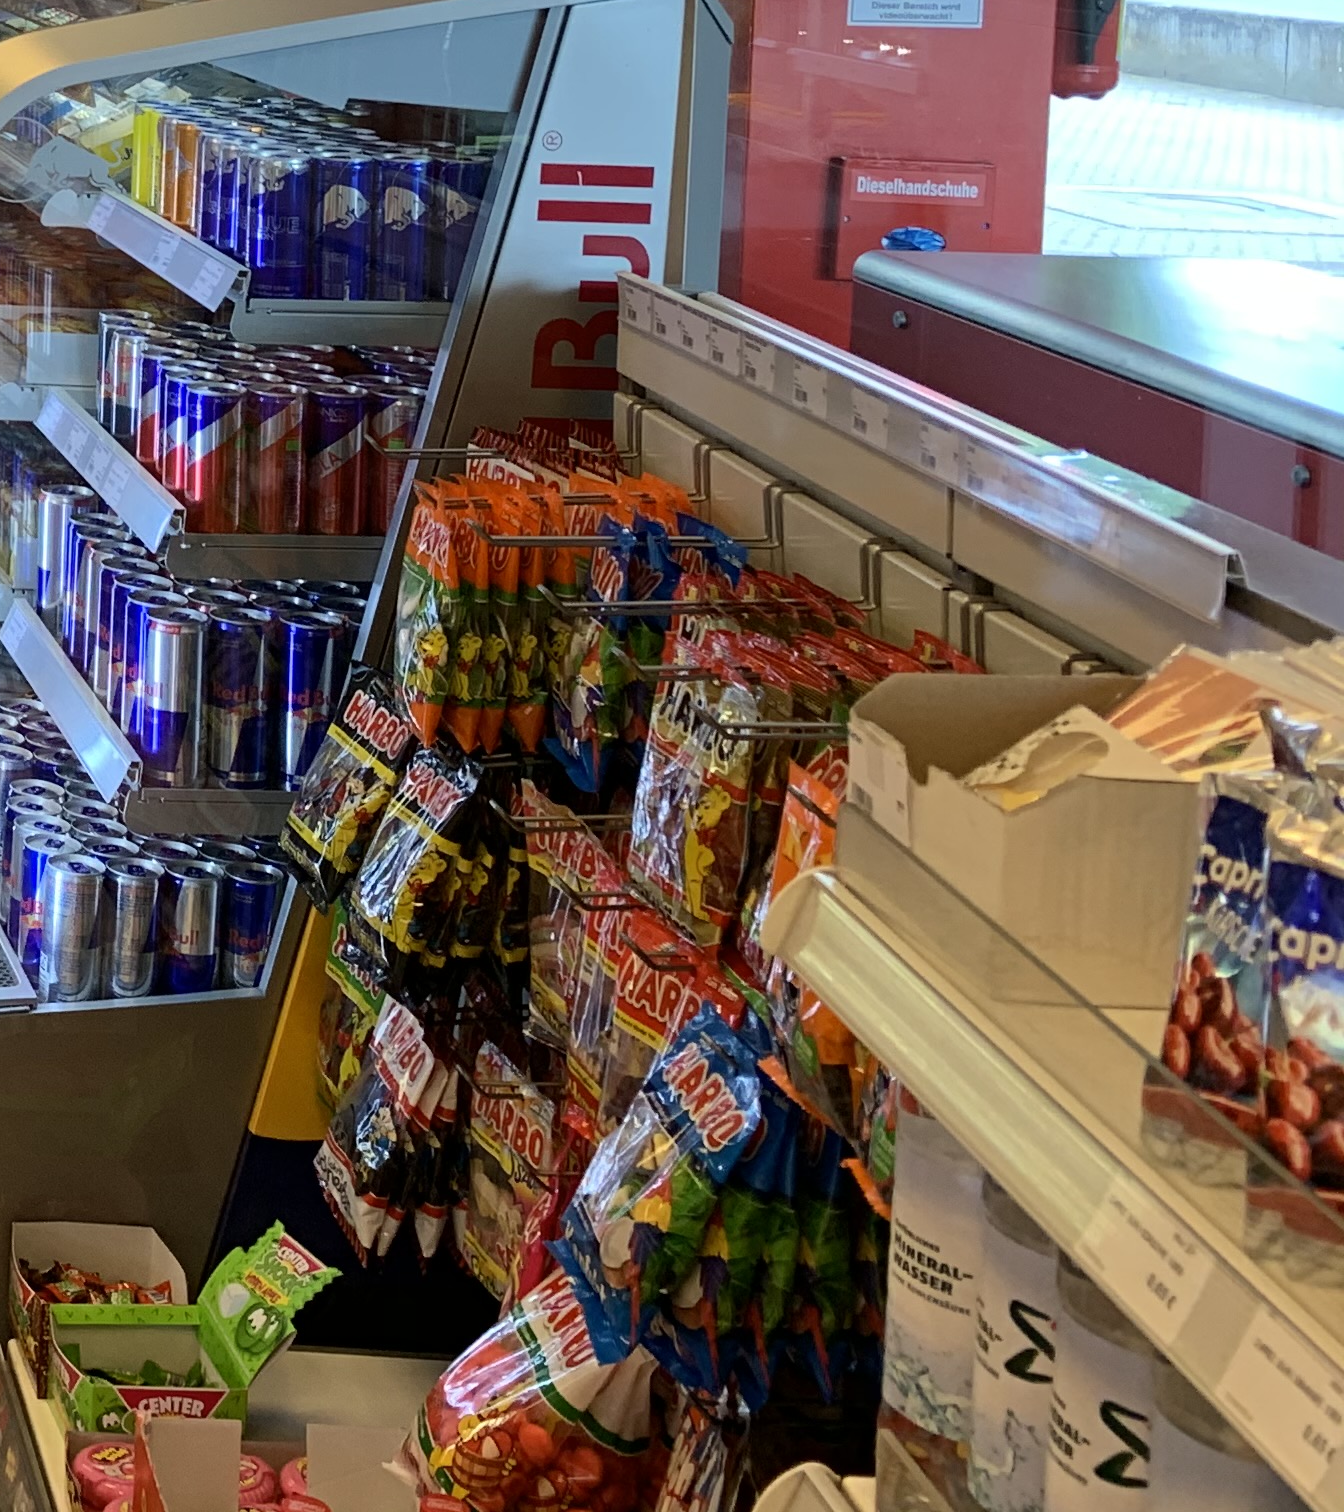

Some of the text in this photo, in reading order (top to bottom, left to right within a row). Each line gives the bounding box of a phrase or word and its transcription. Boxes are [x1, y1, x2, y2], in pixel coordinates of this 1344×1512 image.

[871, 1, 962, 11] Dieser Bereich wird
[856, 176, 979, 199] Dieselhandschuhe
[137, 1396, 205, 1419] CENTER
